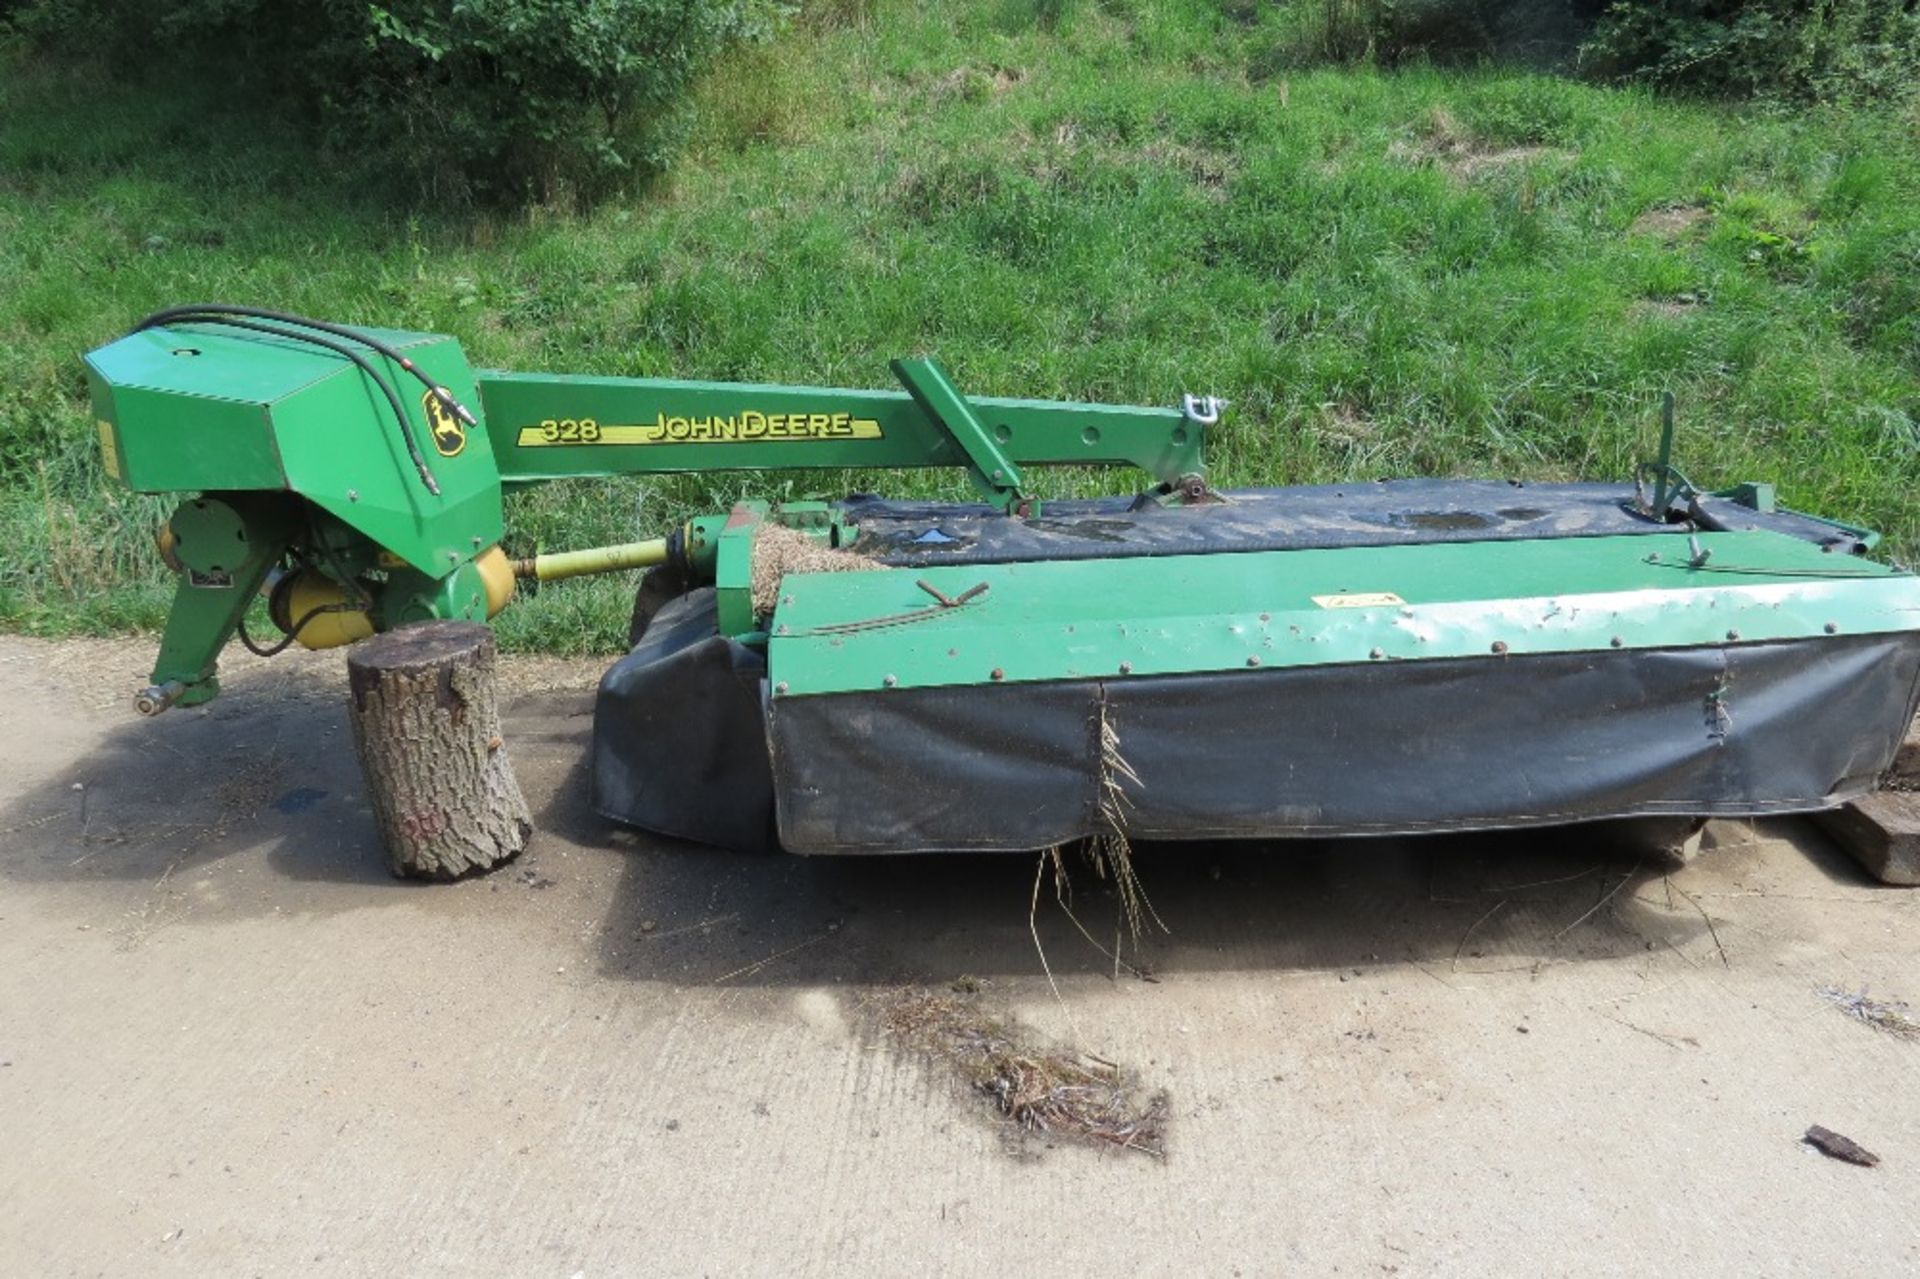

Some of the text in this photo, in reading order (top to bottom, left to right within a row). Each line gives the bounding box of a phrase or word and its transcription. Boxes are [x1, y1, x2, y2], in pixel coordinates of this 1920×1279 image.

[540, 409, 854, 443] 328 JOHN DEERE
